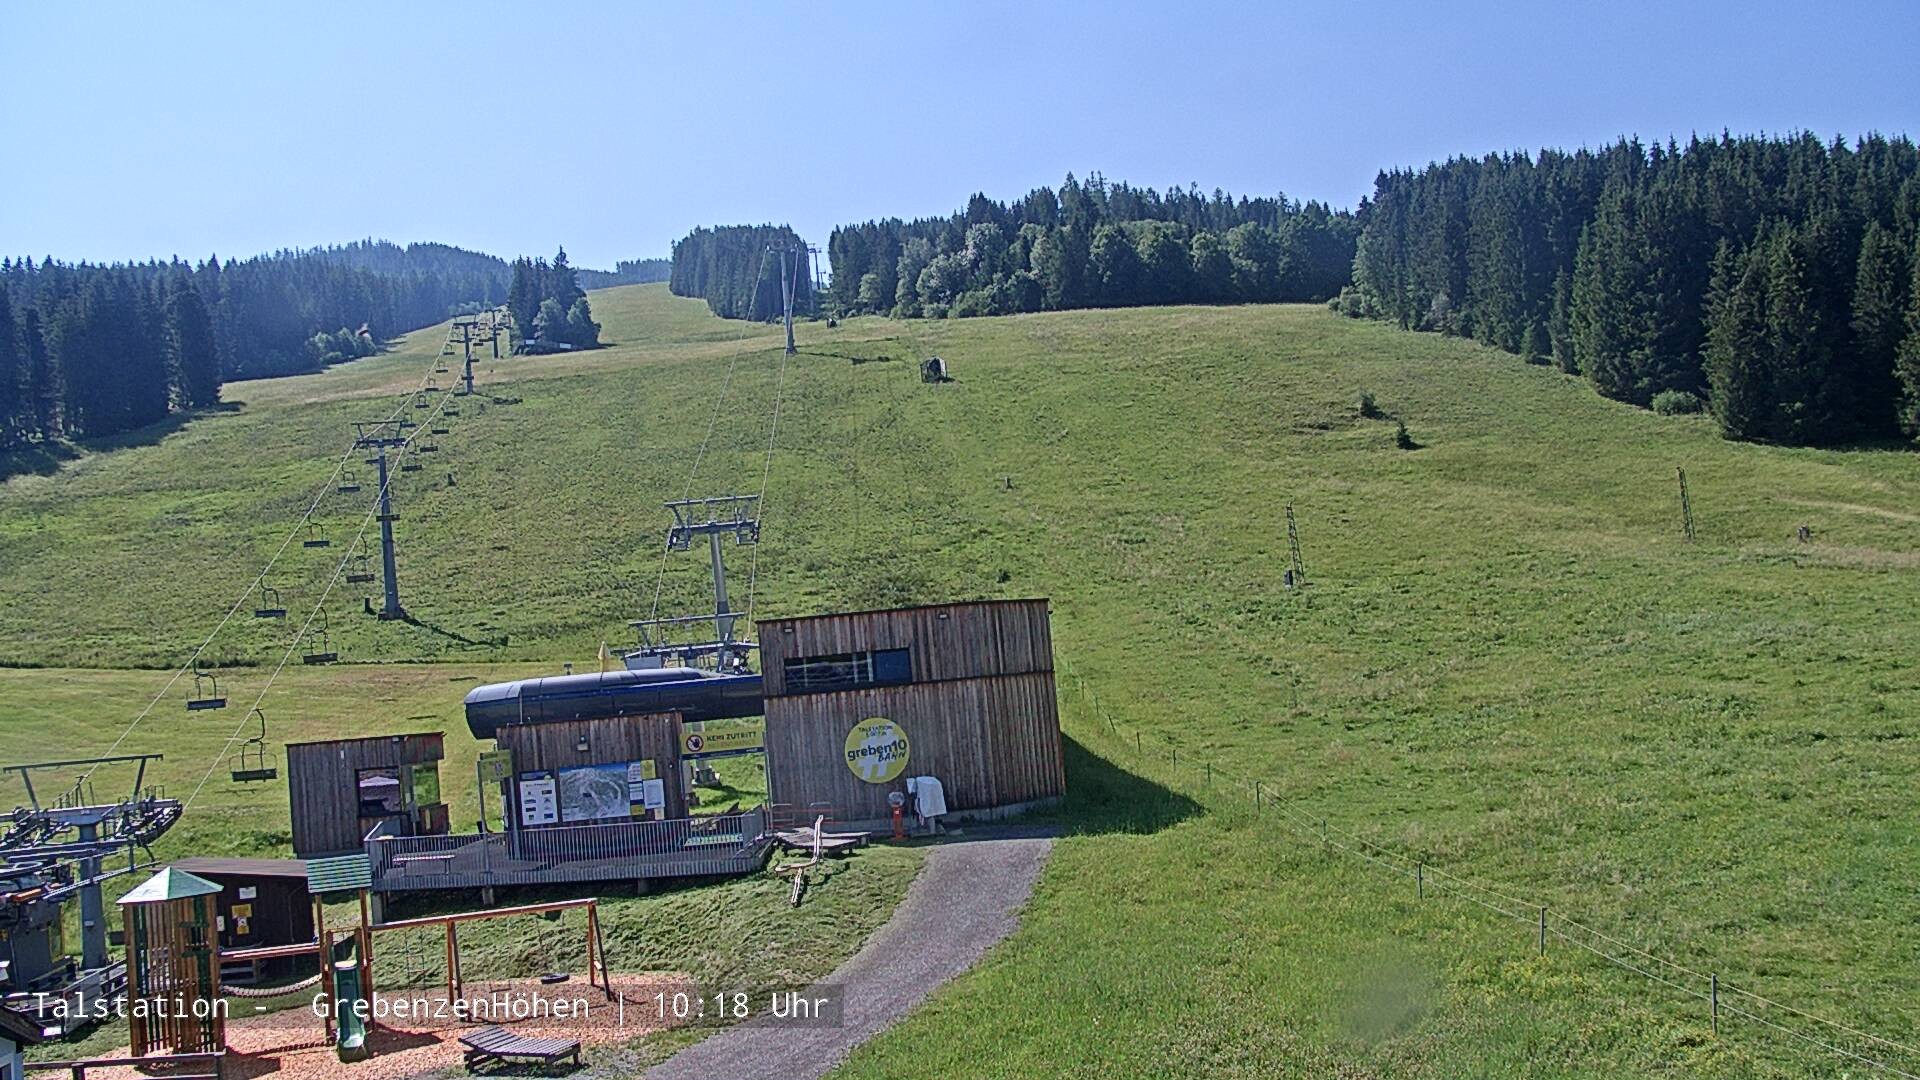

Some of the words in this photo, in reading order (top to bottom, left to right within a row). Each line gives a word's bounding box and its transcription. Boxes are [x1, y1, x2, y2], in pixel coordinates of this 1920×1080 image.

[726, 731, 756, 740] ZUTRITT
[847, 739, 907, 761] greben10
[878, 751, 906, 762] BAHN
